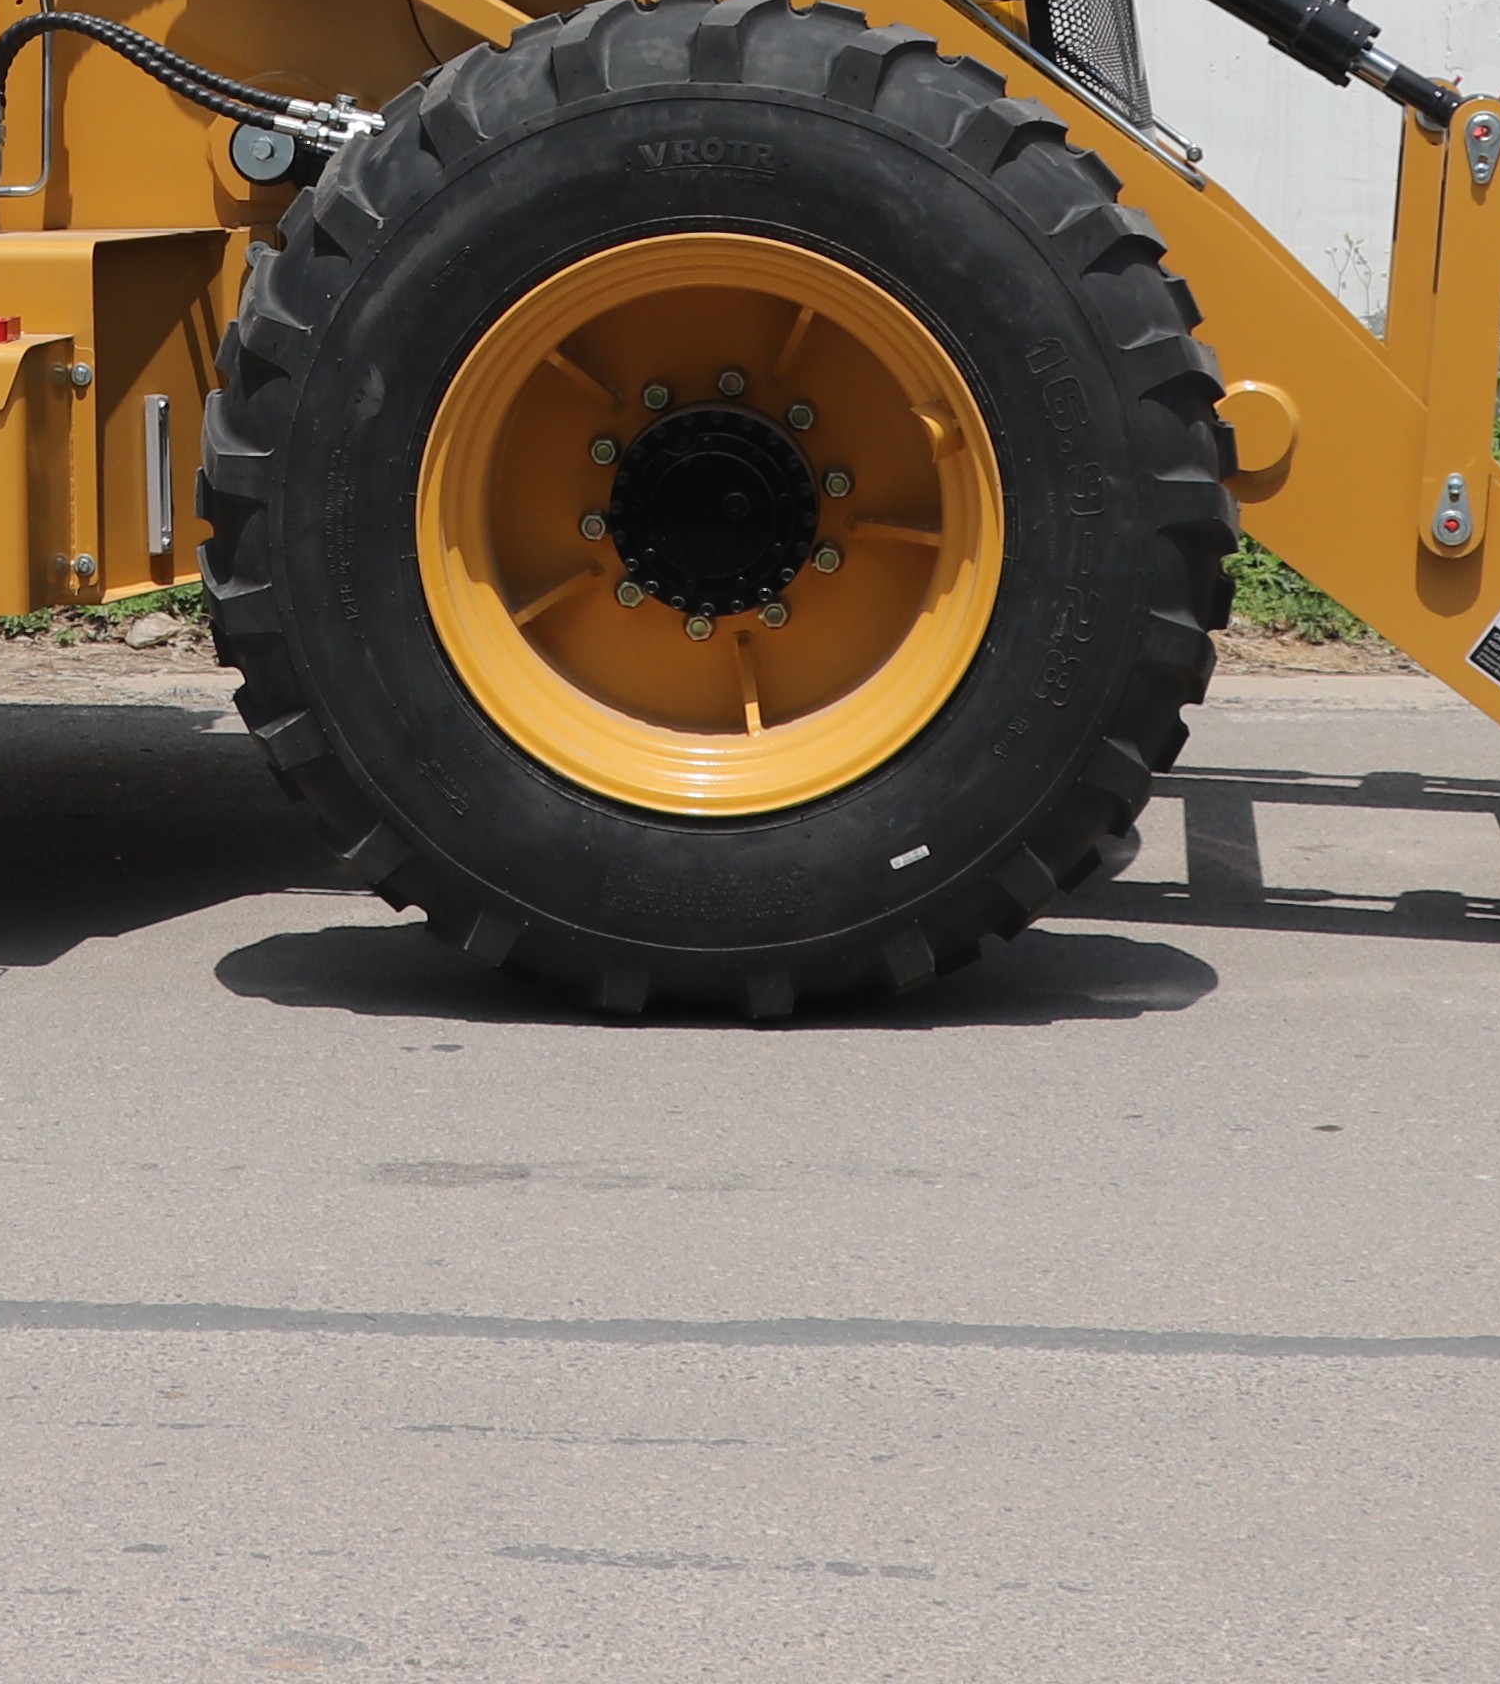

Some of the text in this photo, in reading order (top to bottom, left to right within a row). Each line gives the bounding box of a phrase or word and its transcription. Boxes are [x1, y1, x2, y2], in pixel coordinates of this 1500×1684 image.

[637, 135, 775, 170] VROTR
[1026, 336, 1108, 707] 16.9-28
[339, 582, 360, 620] 12PR
